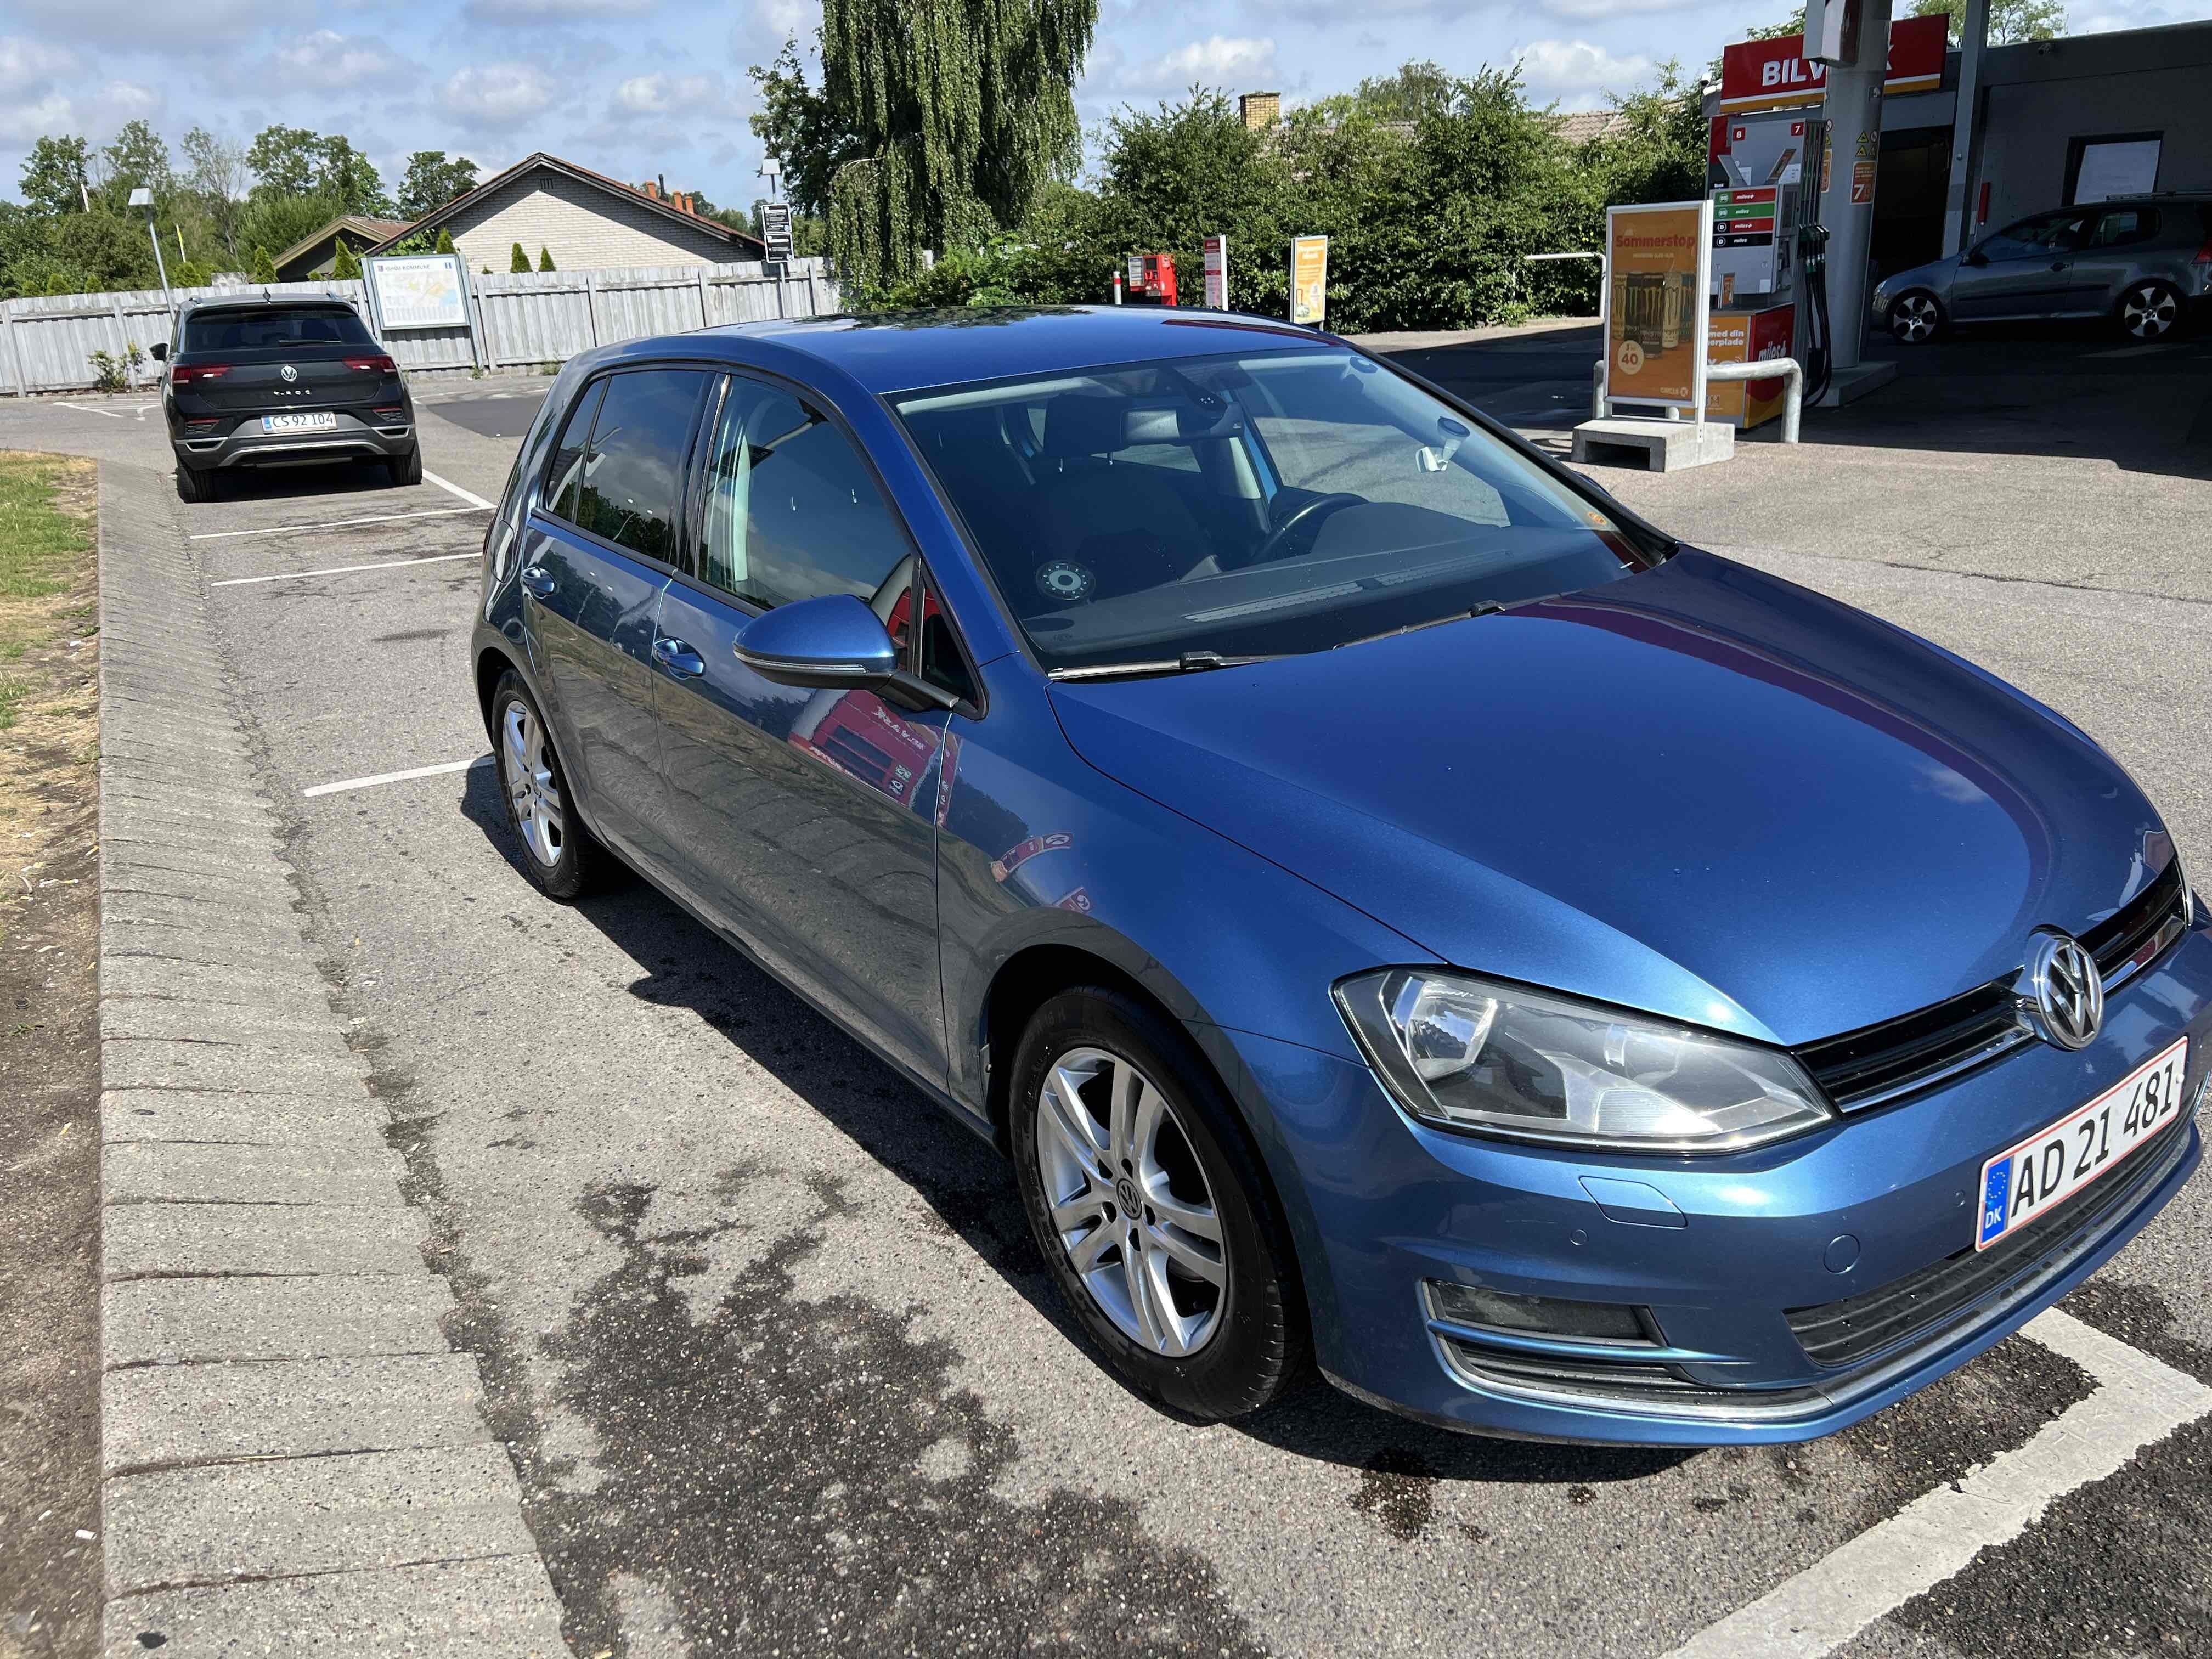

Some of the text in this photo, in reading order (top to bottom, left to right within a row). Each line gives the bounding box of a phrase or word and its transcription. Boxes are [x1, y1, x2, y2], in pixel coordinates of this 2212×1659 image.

[1795, 125, 1800, 134] 7
[1853, 184, 1864, 200] 7
[1621, 353, 1639, 365] 40
[273, 415, 289, 427] CS
[292, 415, 308, 426] 92
[311, 413, 333, 425] 104
[2011, 1060, 2174, 1217] AD 21 481
[1985, 1205, 2002, 1229] DK
